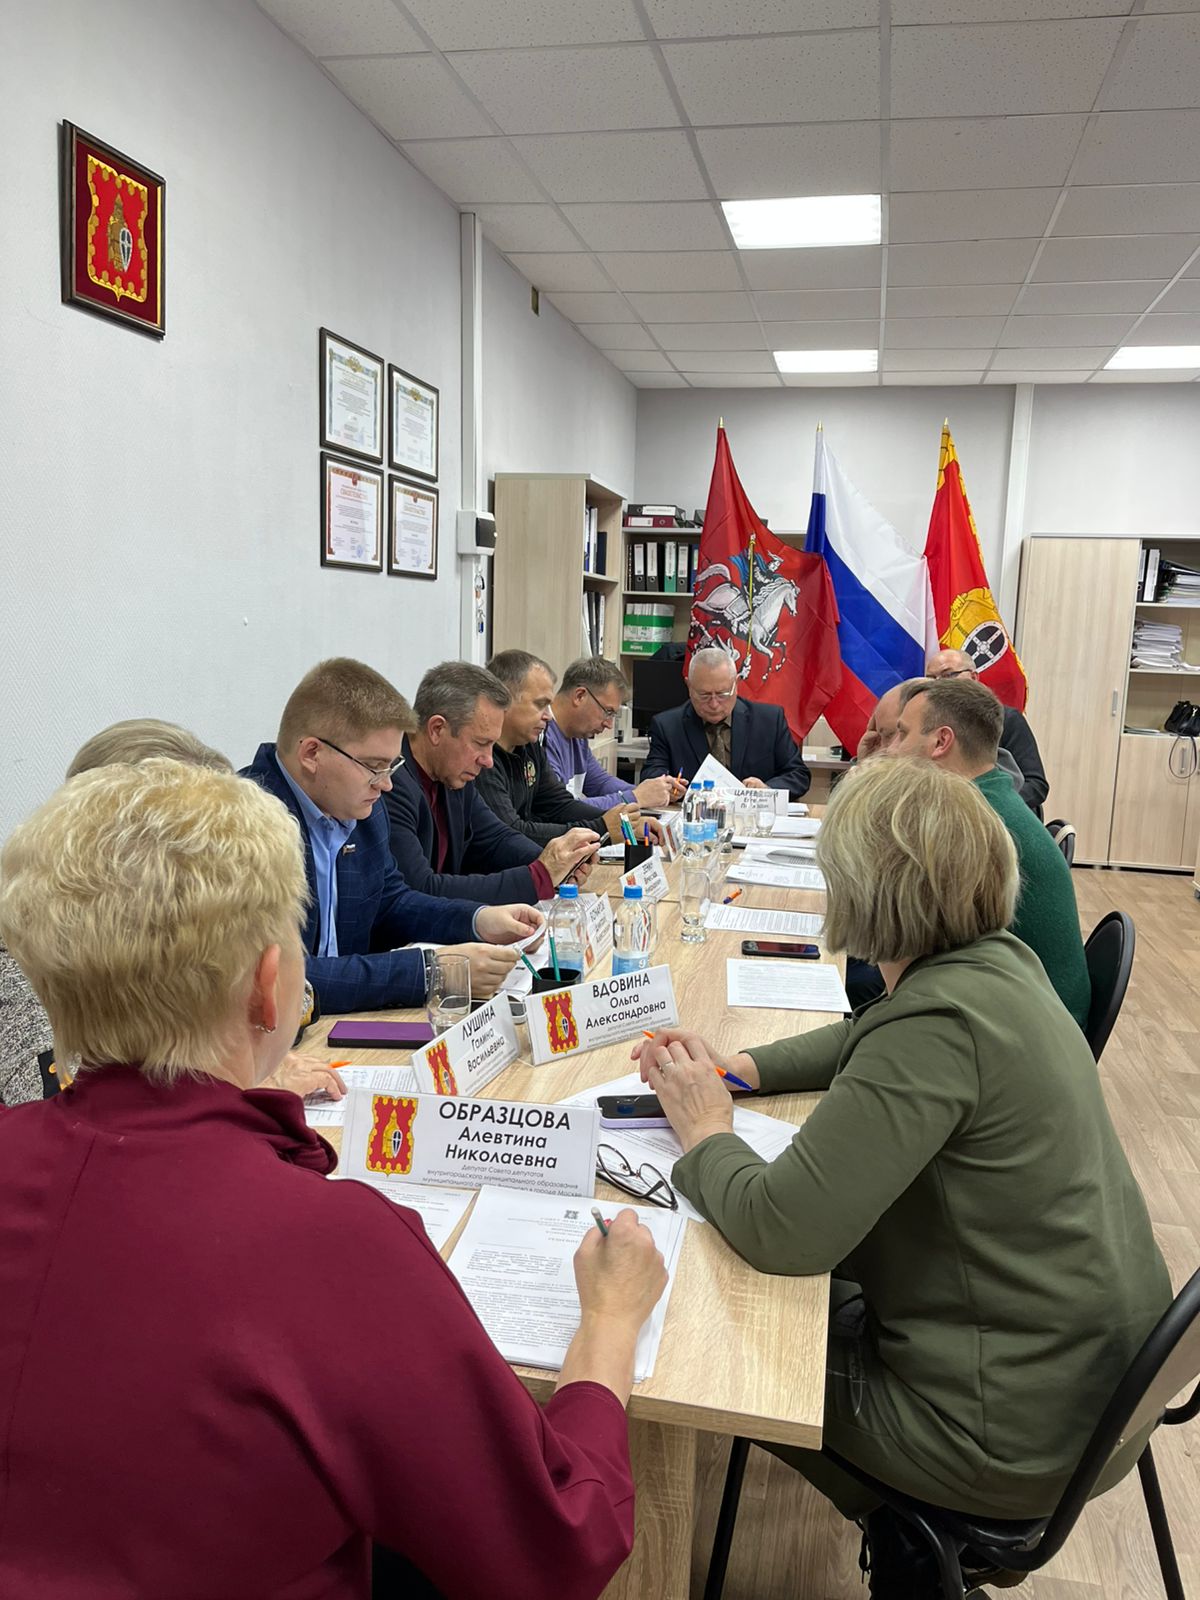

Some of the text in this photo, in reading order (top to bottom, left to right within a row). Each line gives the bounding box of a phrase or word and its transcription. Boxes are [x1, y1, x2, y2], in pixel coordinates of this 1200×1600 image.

[592, 973, 650, 998] ВДОВИНА
[610, 993, 639, 1009] Ольга
[462, 1005, 496, 1041] ЛУШИНА
[585, 1000, 666, 1030] Александровна
[471, 1028, 495, 1052] Галина
[467, 1036, 505, 1072] Васильевна
[439, 1101, 571, 1130] ОБРАЗЦОВА
[458, 1126, 547, 1149] Алевтина
[445, 1144, 557, 1169] Николаевна
[427, 1170, 482, 1180] внутригородского
[483, 1176, 536, 1186] муниципального
[536, 1180, 578, 1189] образования
[461, 1164, 543, 1178] Депутат Совета депутатов
